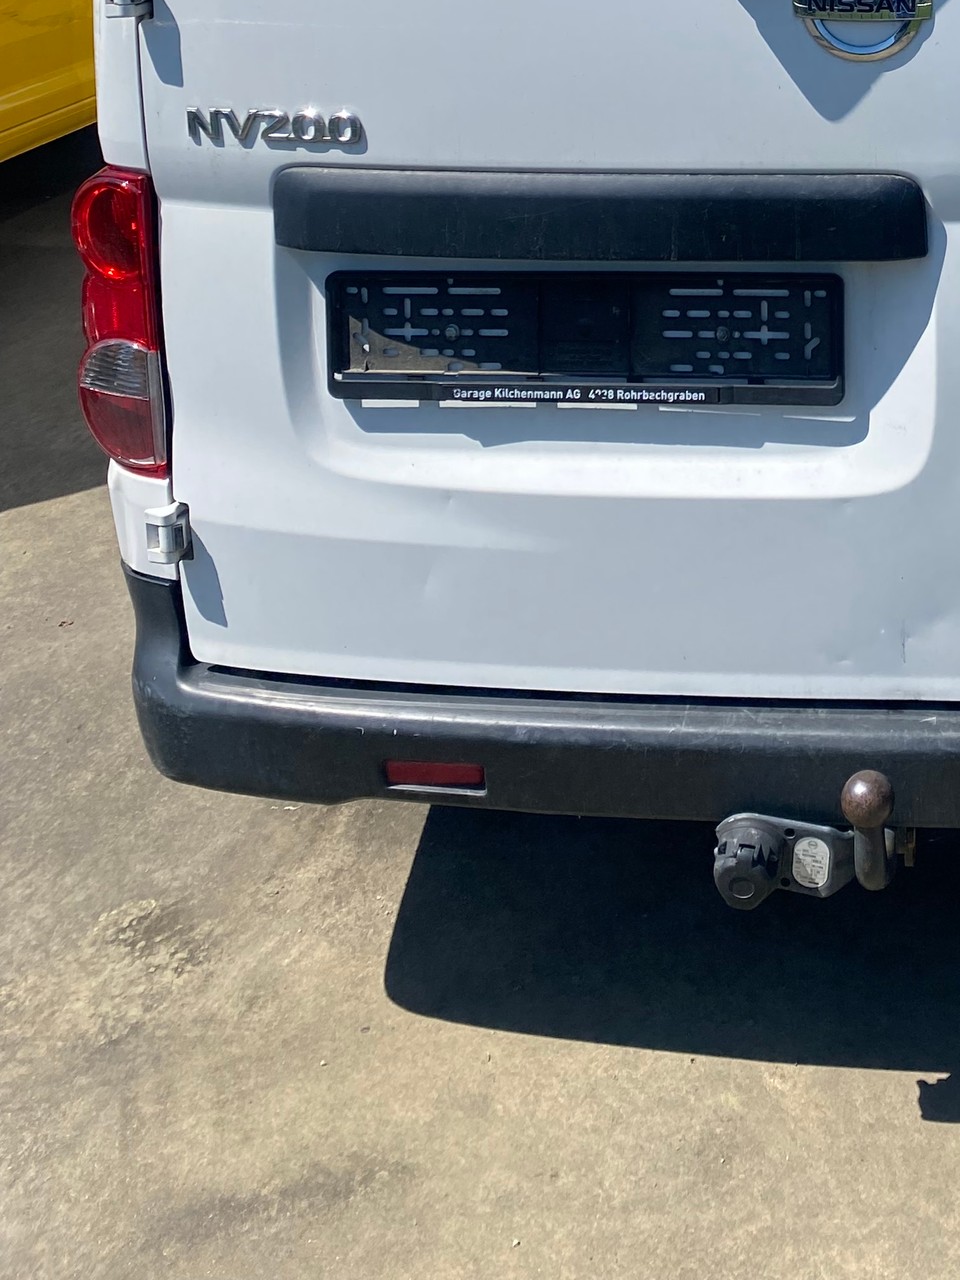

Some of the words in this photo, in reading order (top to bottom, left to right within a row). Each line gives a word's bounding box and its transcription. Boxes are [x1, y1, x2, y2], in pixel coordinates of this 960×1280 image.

[186, 106, 363, 143] NV200
[453, 388, 492, 400] Garage
[494, 388, 563, 399] Kilchenmann
[566, 389, 581, 399] AG
